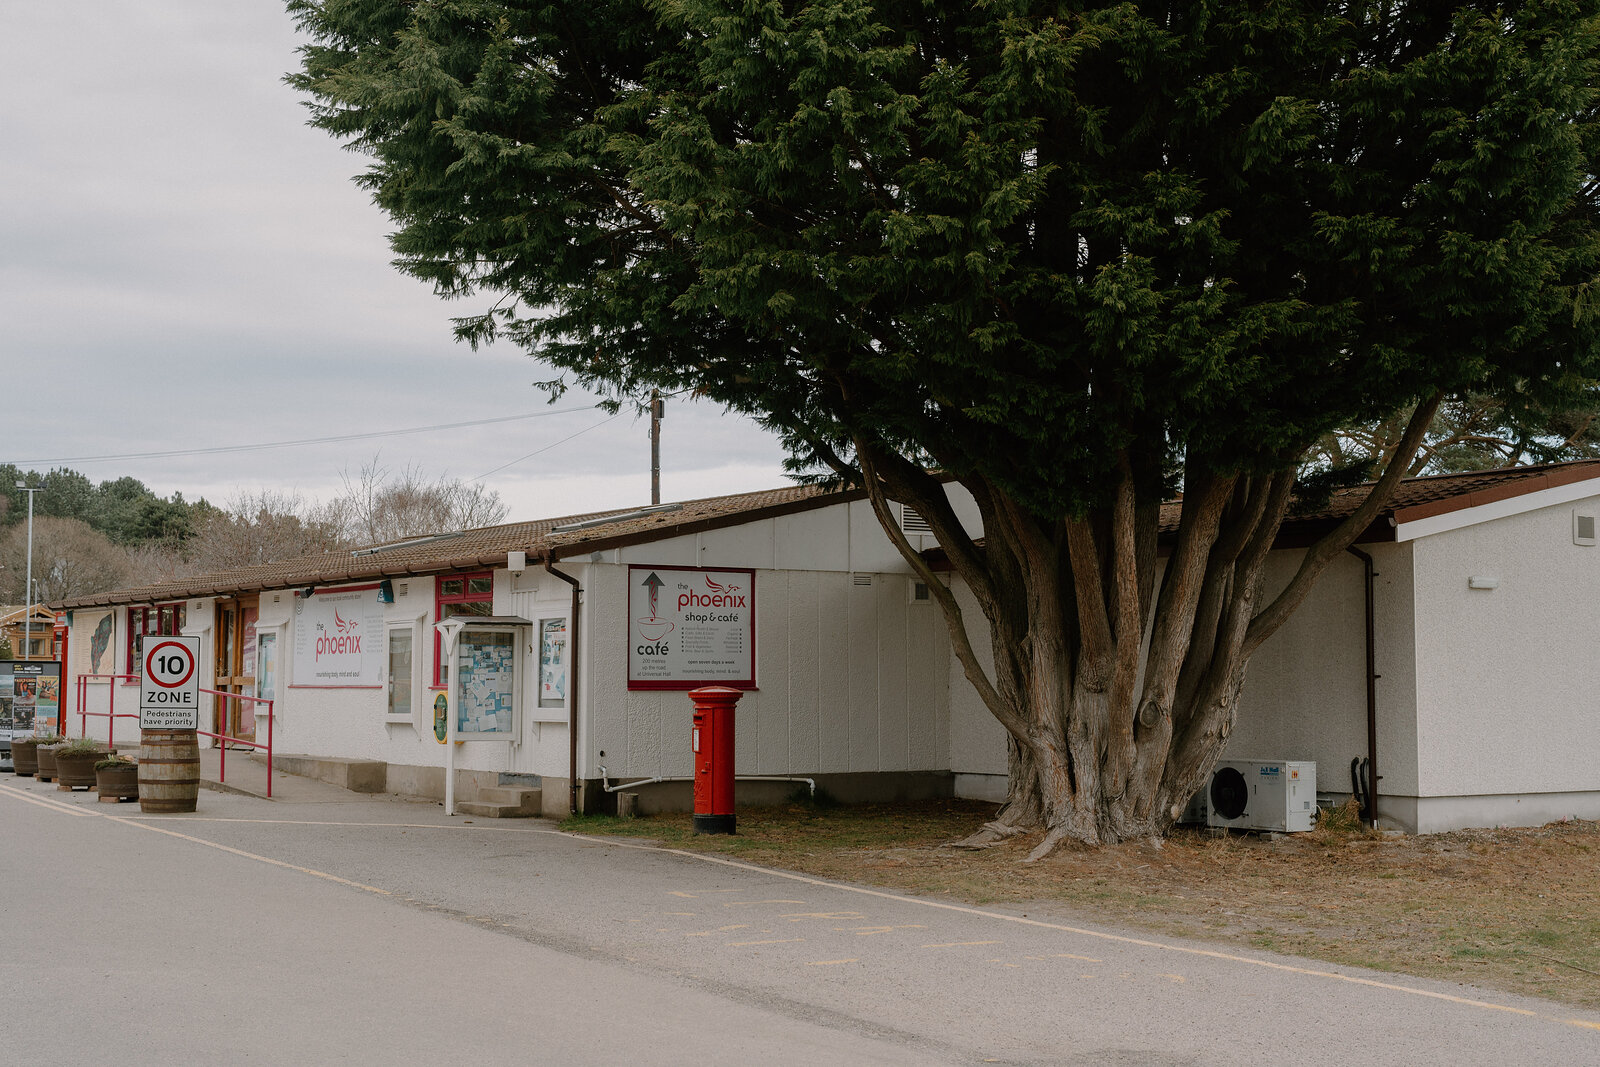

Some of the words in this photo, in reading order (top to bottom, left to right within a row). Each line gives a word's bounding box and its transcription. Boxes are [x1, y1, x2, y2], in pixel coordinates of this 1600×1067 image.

[678, 589, 746, 612] phoenix
[685, 612, 708, 623] shop
[709, 612, 716, 622] &
[717, 613, 739, 622] café
[316, 630, 361, 662] phoenix
[637, 641, 669, 655] café
[158, 656, 184, 674] 10
[147, 692, 191, 703] ZONE
